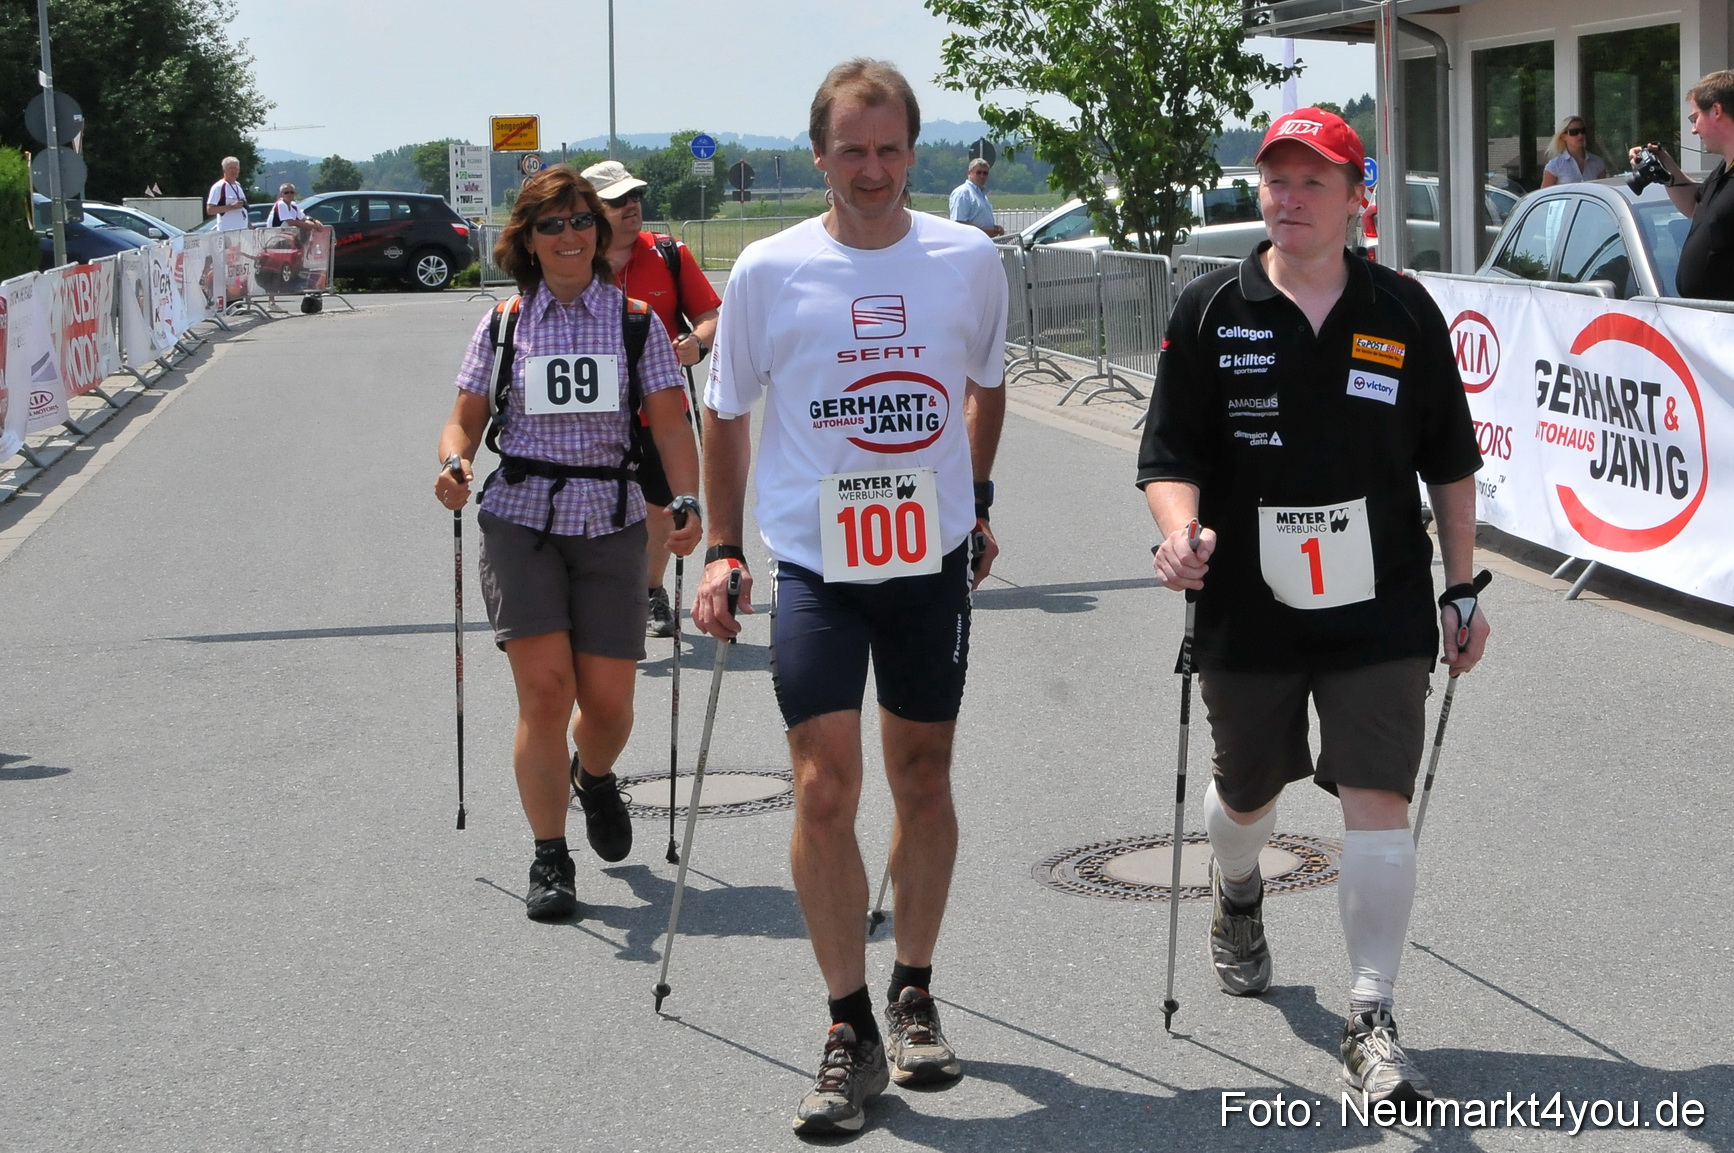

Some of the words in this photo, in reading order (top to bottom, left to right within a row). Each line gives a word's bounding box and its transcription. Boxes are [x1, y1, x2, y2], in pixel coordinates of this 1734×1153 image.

[1217, 326, 1273, 341] Cellagon
[837, 346, 926, 364] SEAT
[1234, 354, 1276, 368] killtec
[1456, 331, 1490, 376] KIA
[1234, 367, 1268, 375] sportswear
[546, 356, 598, 406] 69
[1366, 381, 1394, 396] victory
[1228, 398, 1279, 409] AMADEUS
[1535, 359, 1661, 436] GERHART
[1664, 396, 1680, 432] &
[810, 394, 927, 420] GERHART
[928, 396, 936, 407] &
[813, 417, 864, 429] AUTOHAUS
[863, 413, 939, 434] JÄNIG
[1250, 438, 1268, 446] data
[1590, 430, 1689, 500] JÄNIG
[838, 476, 892, 492] MEYER
[838, 489, 894, 500] WERBUNG
[1276, 512, 1326, 524] MEYER
[837, 501, 927, 568] 100
[1276, 524, 1328, 534] WERBUNG
[1300, 538, 1324, 596] 1
[1183, 642, 1192, 680] LEKI
